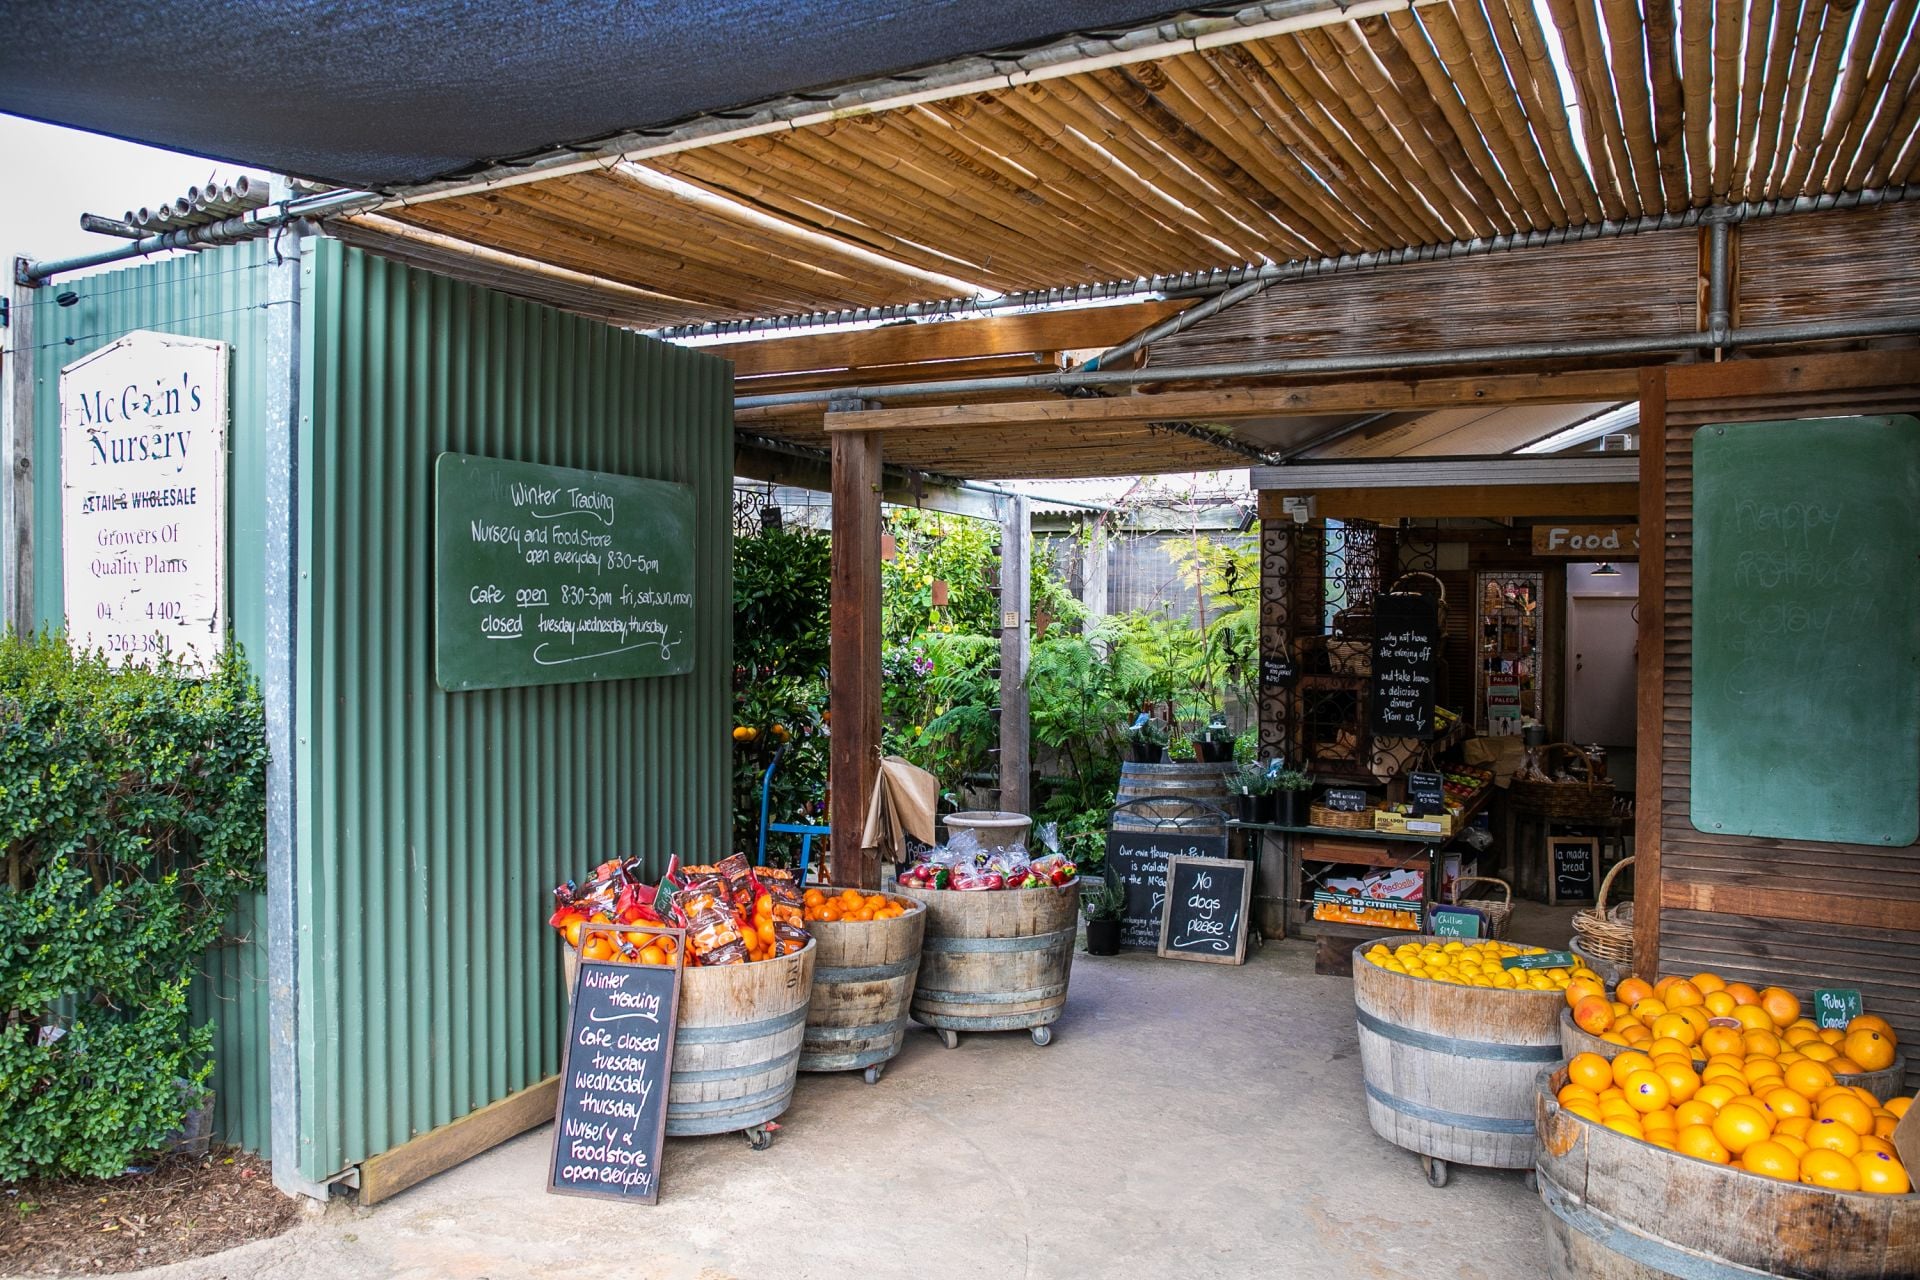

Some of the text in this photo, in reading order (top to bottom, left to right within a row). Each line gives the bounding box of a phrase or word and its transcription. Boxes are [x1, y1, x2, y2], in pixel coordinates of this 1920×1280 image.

[89, 430, 192, 473] Nursery
[132, 487, 197, 509] WHOLESALE
[511, 483, 615, 525] Winter Trading
[98, 522, 180, 547] Growers Of
[471, 519, 520, 553] Nursery
[524, 526, 547, 544] and
[1549, 528, 1619, 550] Food
[91, 555, 188, 578] Quality Plants
[526, 549, 550, 569] open
[554, 550, 600, 576] everyday
[470, 585, 505, 604] Cafe
[516, 588, 547, 607] open
[481, 614, 522, 632] closed
[1380, 647, 1392, 658] the
[1420, 647, 1431, 661] off
[1381, 670, 1394, 681] and
[1389, 686, 1420, 697] delicious
[1382, 707, 1401, 723] from
[1119, 845, 1133, 856] Our
[1566, 848, 1589, 860] madre
[1131, 860, 1138, 871] is
[1562, 861, 1585, 872] bread
[1129, 874, 1142, 885] the
[1192, 872, 1211, 890] No
[1188, 894, 1220, 919] dogs
[1366, 900, 1398, 910] CITRUS
[586, 969, 628, 989] Winter
[609, 993, 661, 1018] trading
[1821, 993, 1846, 1012] Ruby
[580, 1026, 661, 1052] Cafe closed
[592, 1051, 646, 1080] tuesday
[580, 1092, 645, 1131] thursday
[566, 1118, 618, 1151] Nursery
[562, 1165, 598, 1183] open
